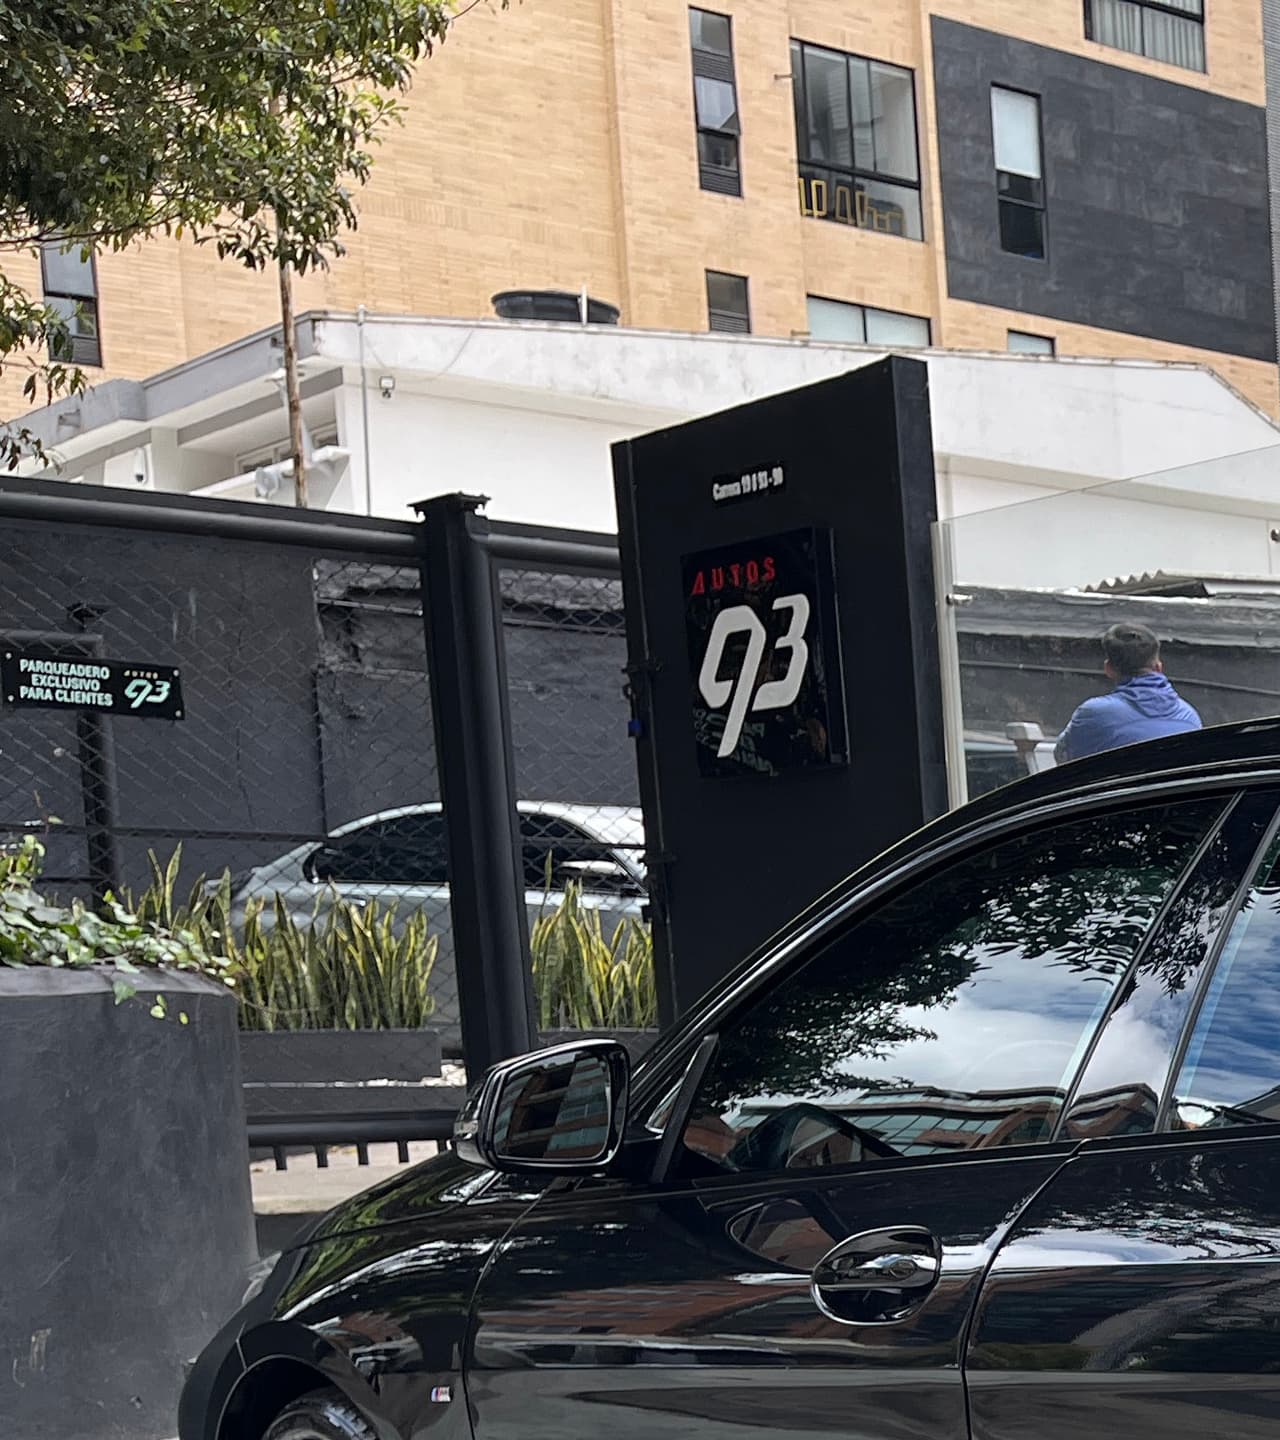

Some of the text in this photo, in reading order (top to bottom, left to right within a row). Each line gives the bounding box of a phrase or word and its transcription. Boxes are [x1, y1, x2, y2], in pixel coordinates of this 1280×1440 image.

[690, 557, 776, 595] AUTOS
[19, 659, 110, 680] PARQUEADERO
[699, 593, 810, 758] 93
[31, 673, 100, 692] EXCLUSIVO
[124, 679, 171, 709] 93
[19, 686, 113, 706] PARA CLIENTES
